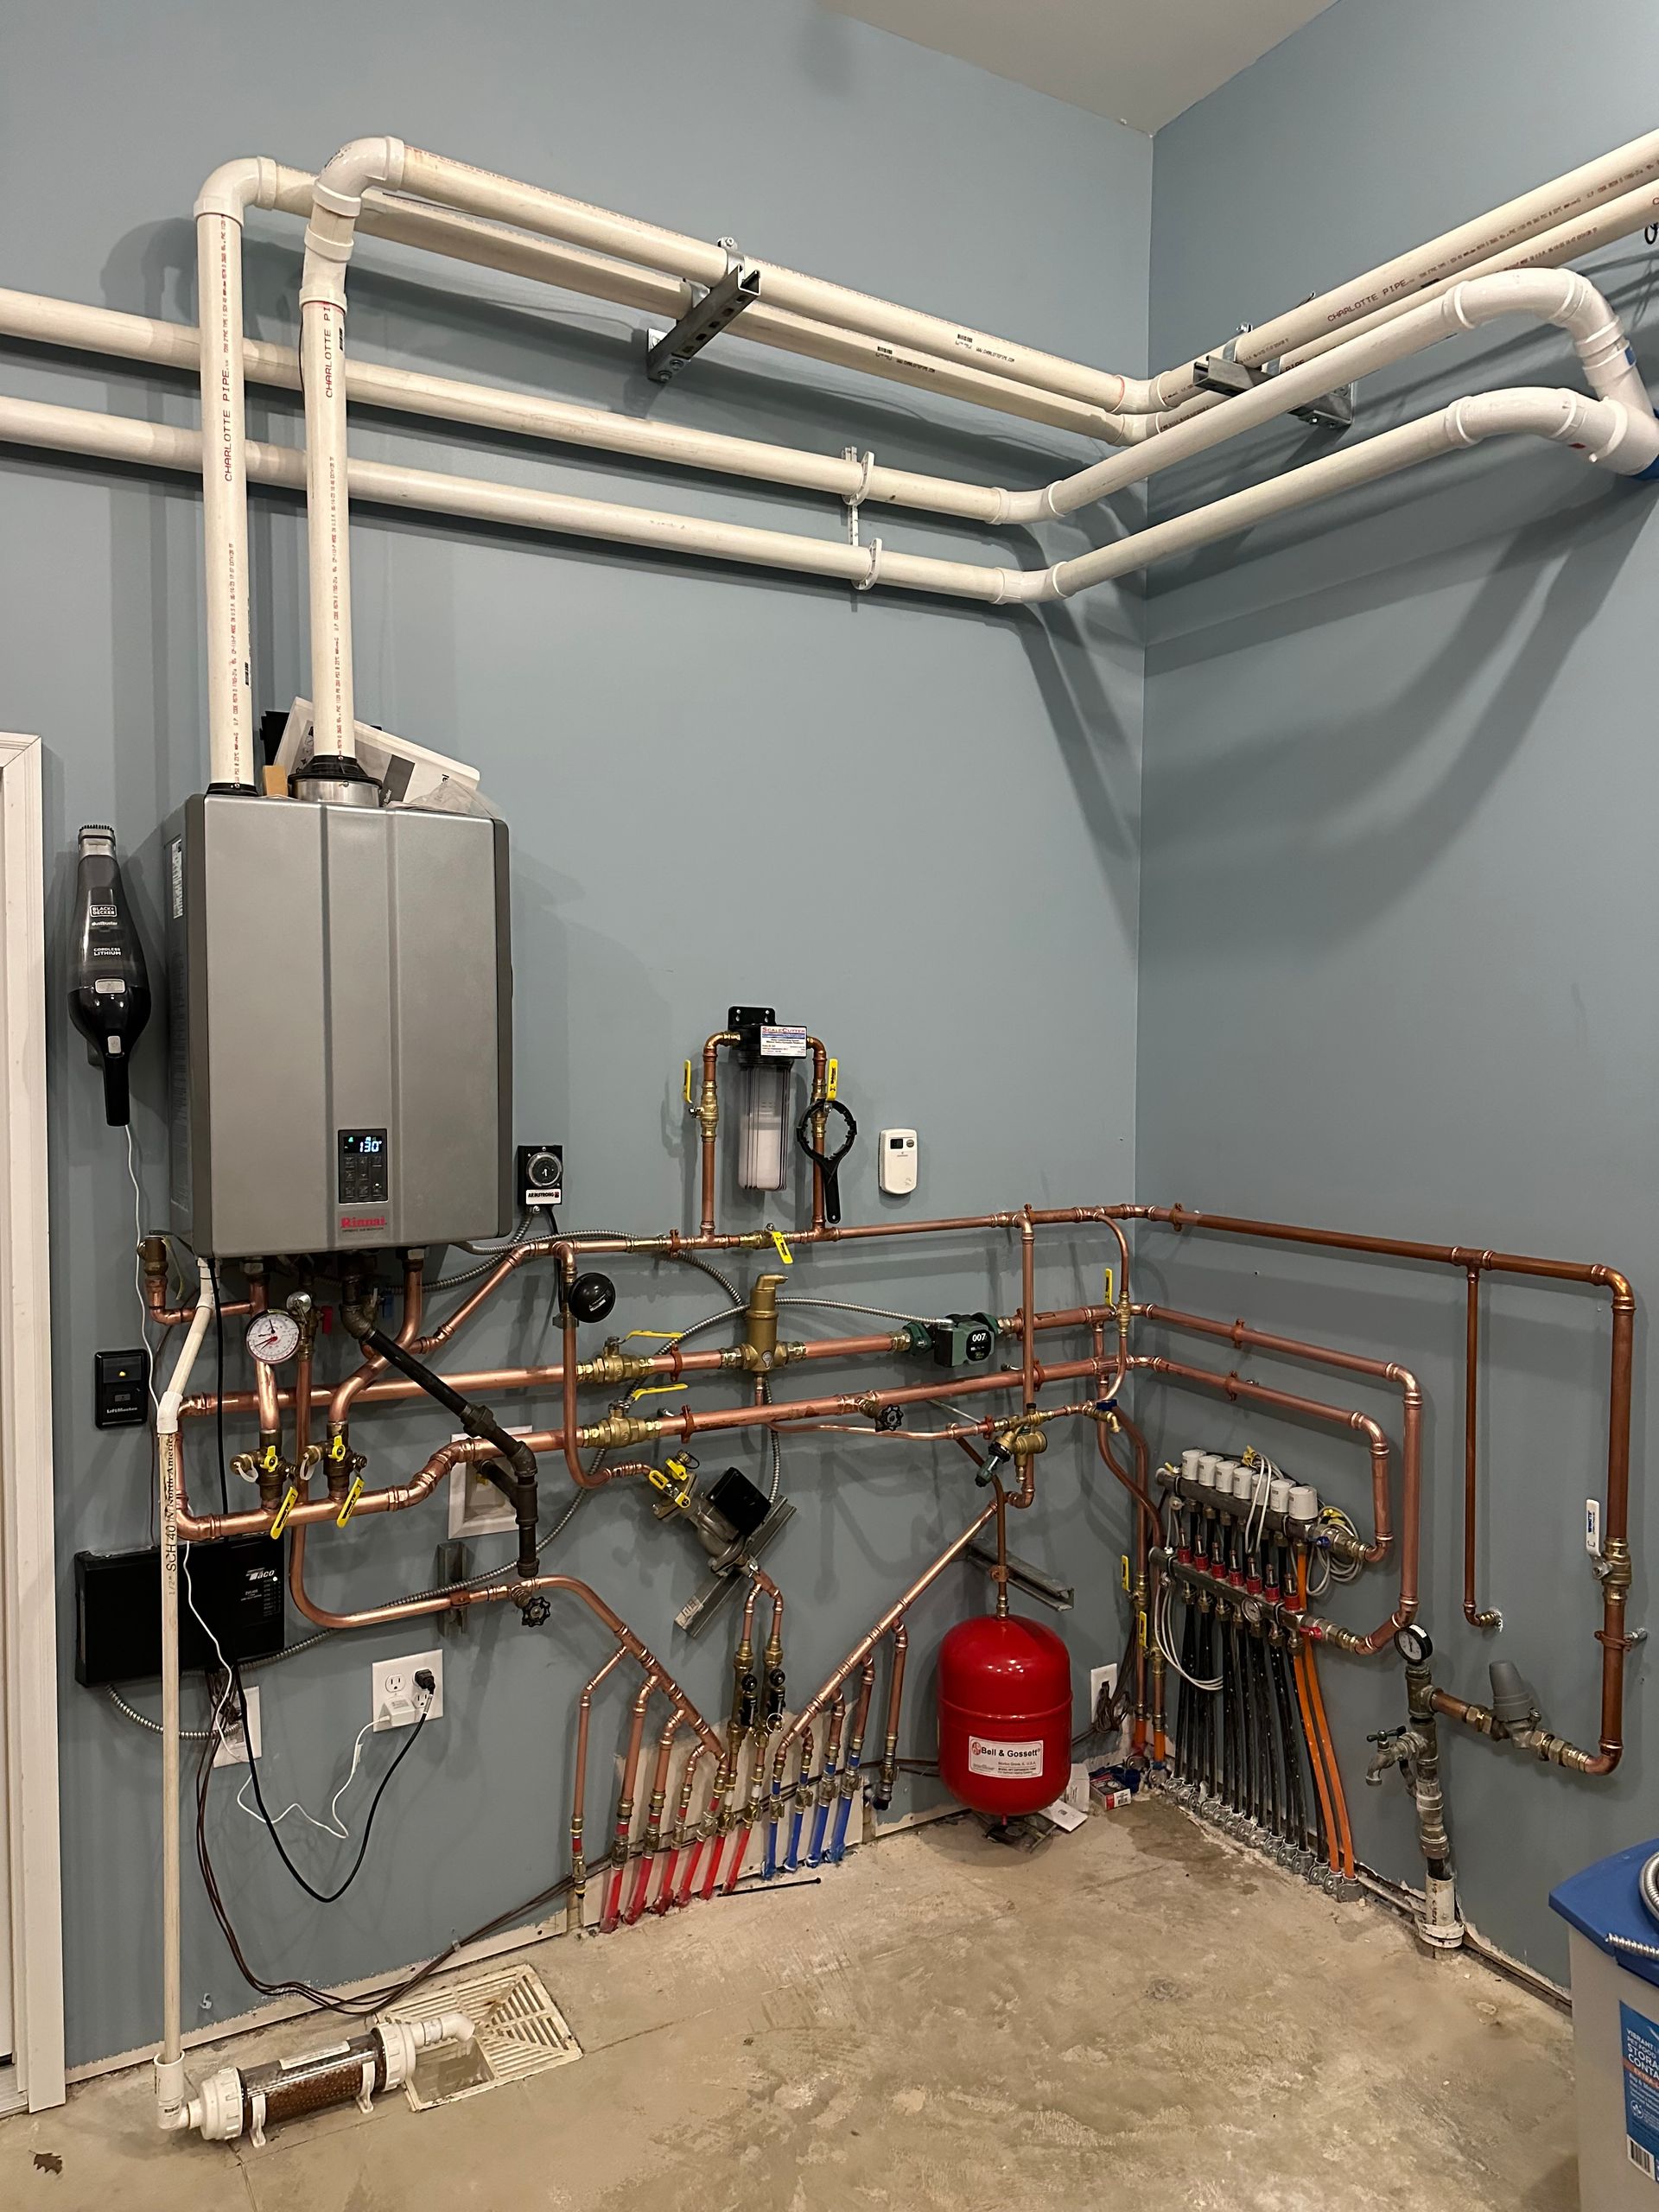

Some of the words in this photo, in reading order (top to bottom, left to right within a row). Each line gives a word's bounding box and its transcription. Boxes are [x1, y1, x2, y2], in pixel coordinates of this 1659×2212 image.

[1327, 293, 1379, 321] CHARLOTTE
[1382, 278, 1407, 296] PIPE
[324, 328, 334, 398] CHARLOTTE
[221, 369, 230, 402] PIPE
[223, 410, 232, 482] CHARLOTTE
[341, 1216, 387, 1228] Rinnai
[165, 1525, 176, 1541] 40
[166, 1542, 177, 1572] SCH
[982, 1746, 996, 1756] Bell
[1626, 2028, 1654, 2049] VIBRANT
[1627, 2036, 1637, 2047] PET
[1638, 2044, 1656, 2059] FOOD
[1627, 2043, 1659, 2070] STORA
